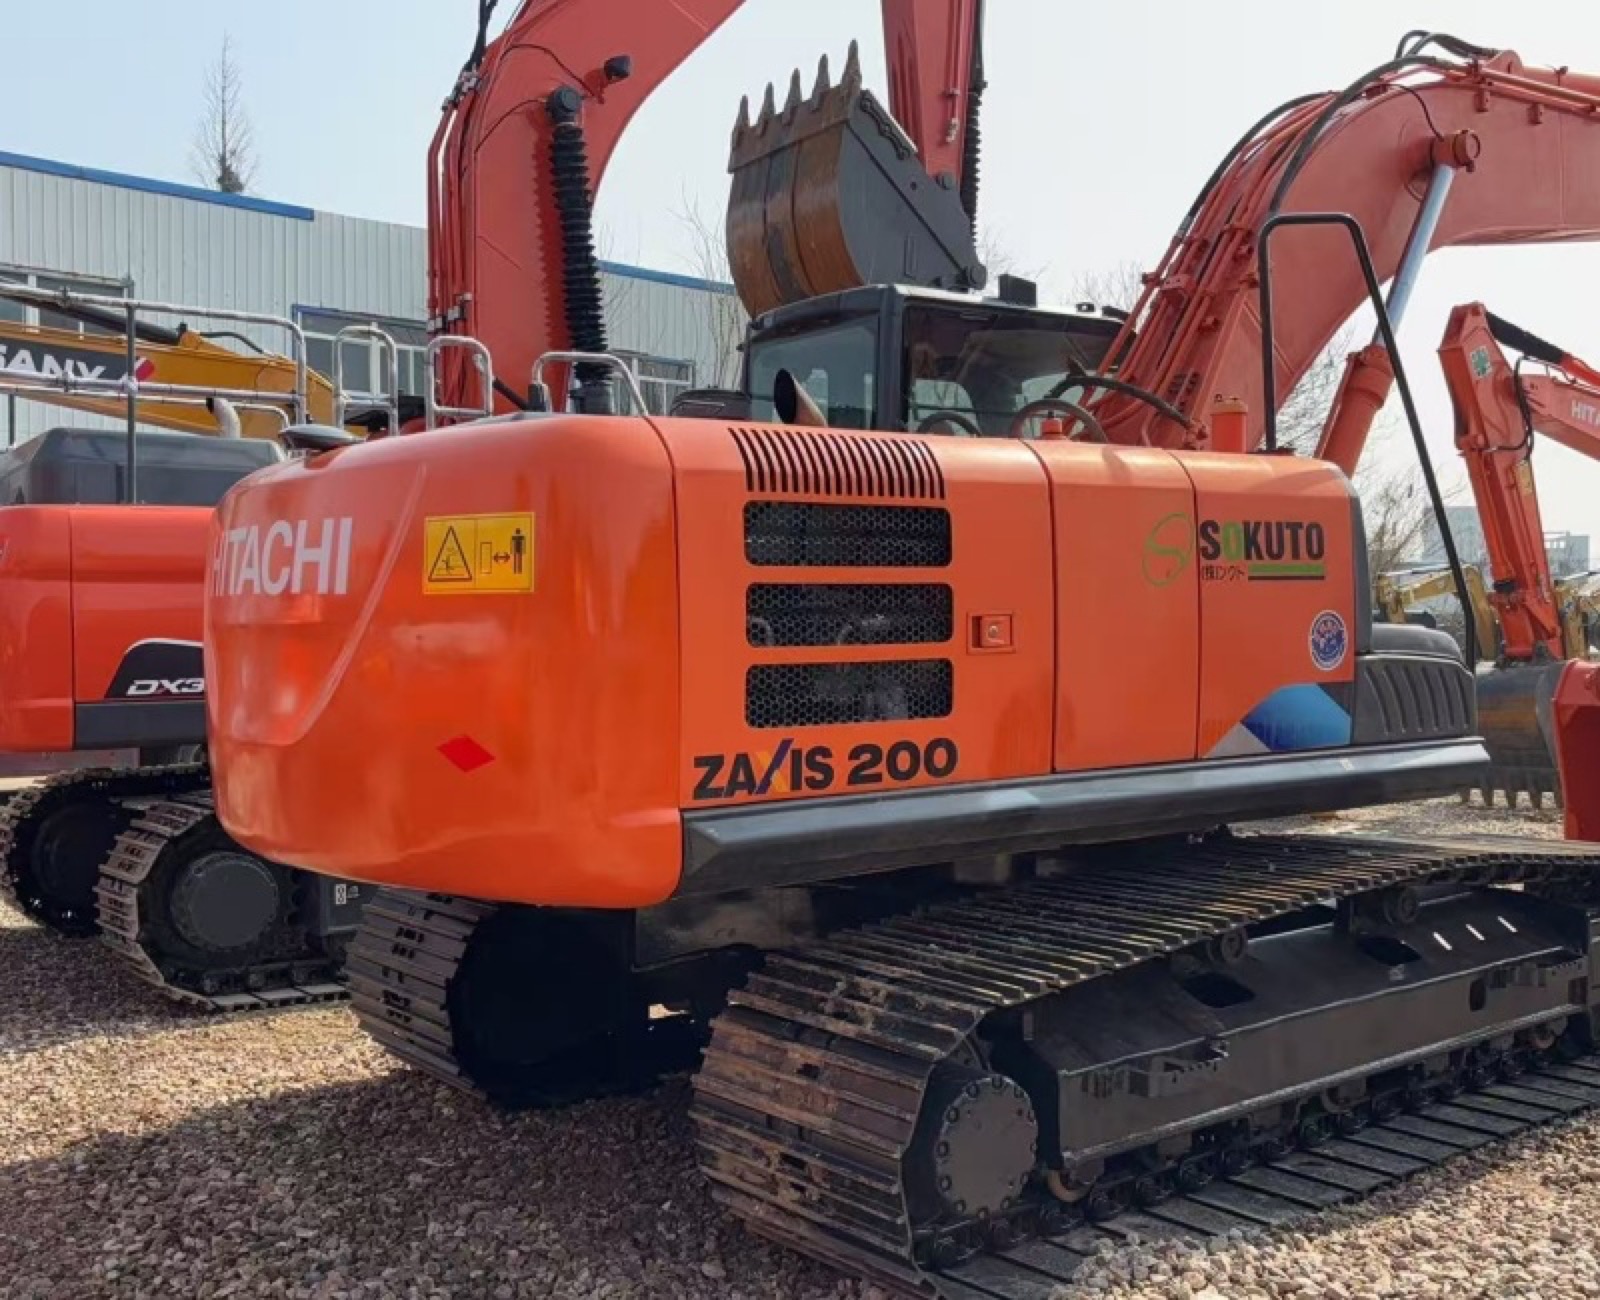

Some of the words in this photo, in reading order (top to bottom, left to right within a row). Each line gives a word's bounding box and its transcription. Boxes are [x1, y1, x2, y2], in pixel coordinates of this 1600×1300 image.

[0, 344, 106, 379] ANY
[212, 517, 353, 597] HITACHI
[1200, 520, 1325, 561] SOKUTO
[693, 738, 835, 800] ZAXIS
[848, 737, 958, 786] 200
